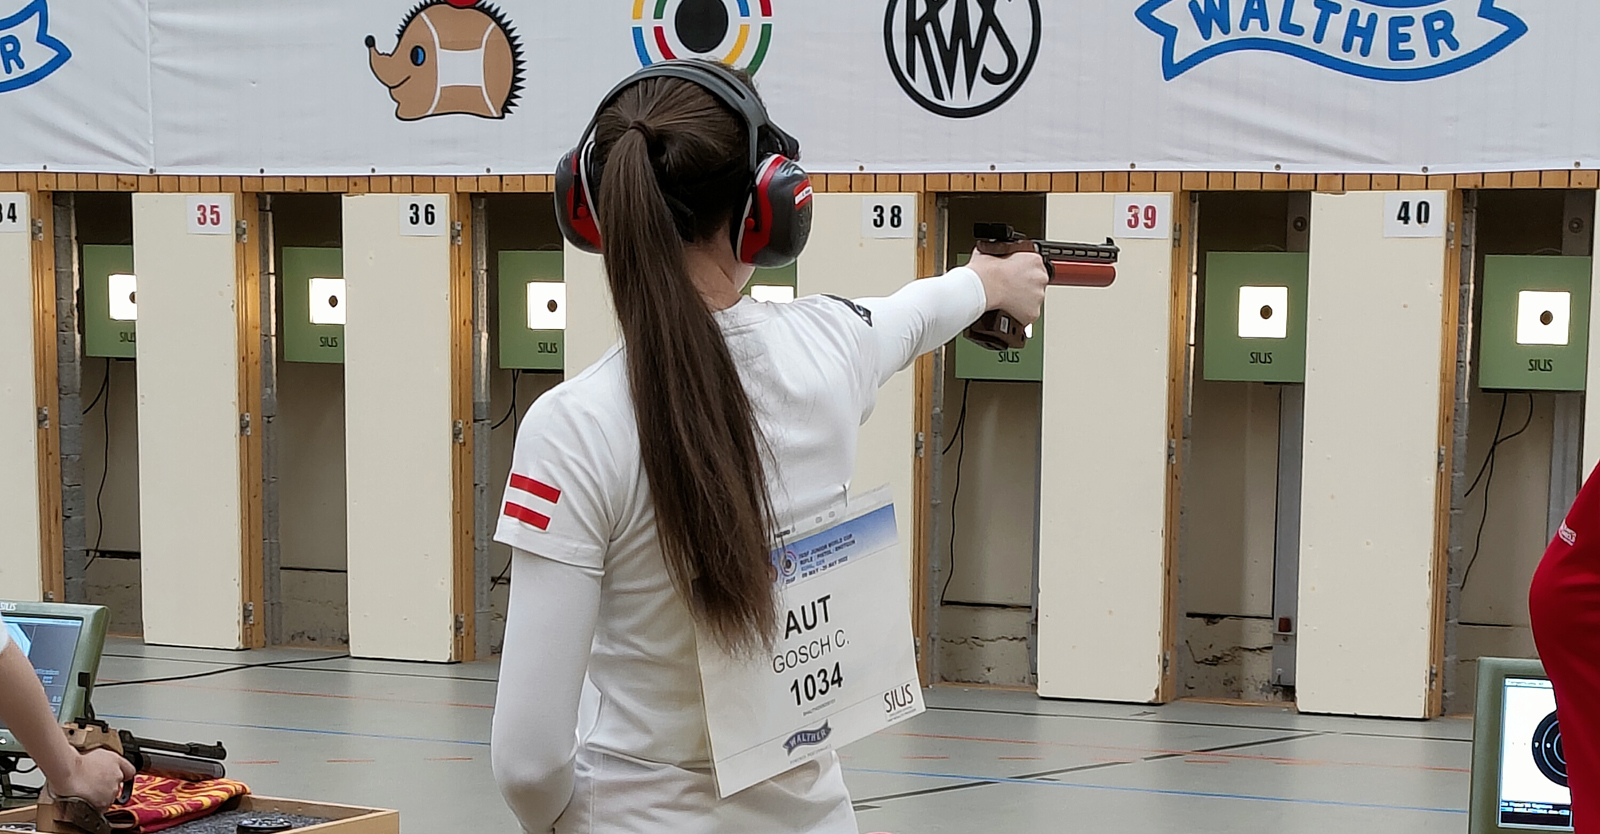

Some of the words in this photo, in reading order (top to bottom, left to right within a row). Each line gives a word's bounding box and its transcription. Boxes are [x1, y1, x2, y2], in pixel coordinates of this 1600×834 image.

[1188, 0, 1460, 62] WALTHER
[906, 0, 1019, 102] RWS
[197, 204, 221, 226] 35
[409, 203, 436, 226] 36
[873, 205, 902, 228] 38
[1127, 205, 1157, 229] 39
[1397, 201, 1430, 225] 40
[320, 336, 338, 348] SIUS
[538, 342, 558, 354] SIUS
[998, 351, 1020, 363] SIUS
[1249, 352, 1273, 364] SIUS
[1528, 359, 1553, 372] SIUS
[785, 594, 831, 639] AUT
[772, 634, 831, 674] GOSCH
[835, 629, 850, 648] C.
[790, 661, 844, 706] 1034
[883, 683, 914, 714] SIUS
[789, 728, 827, 748] WALTHER
